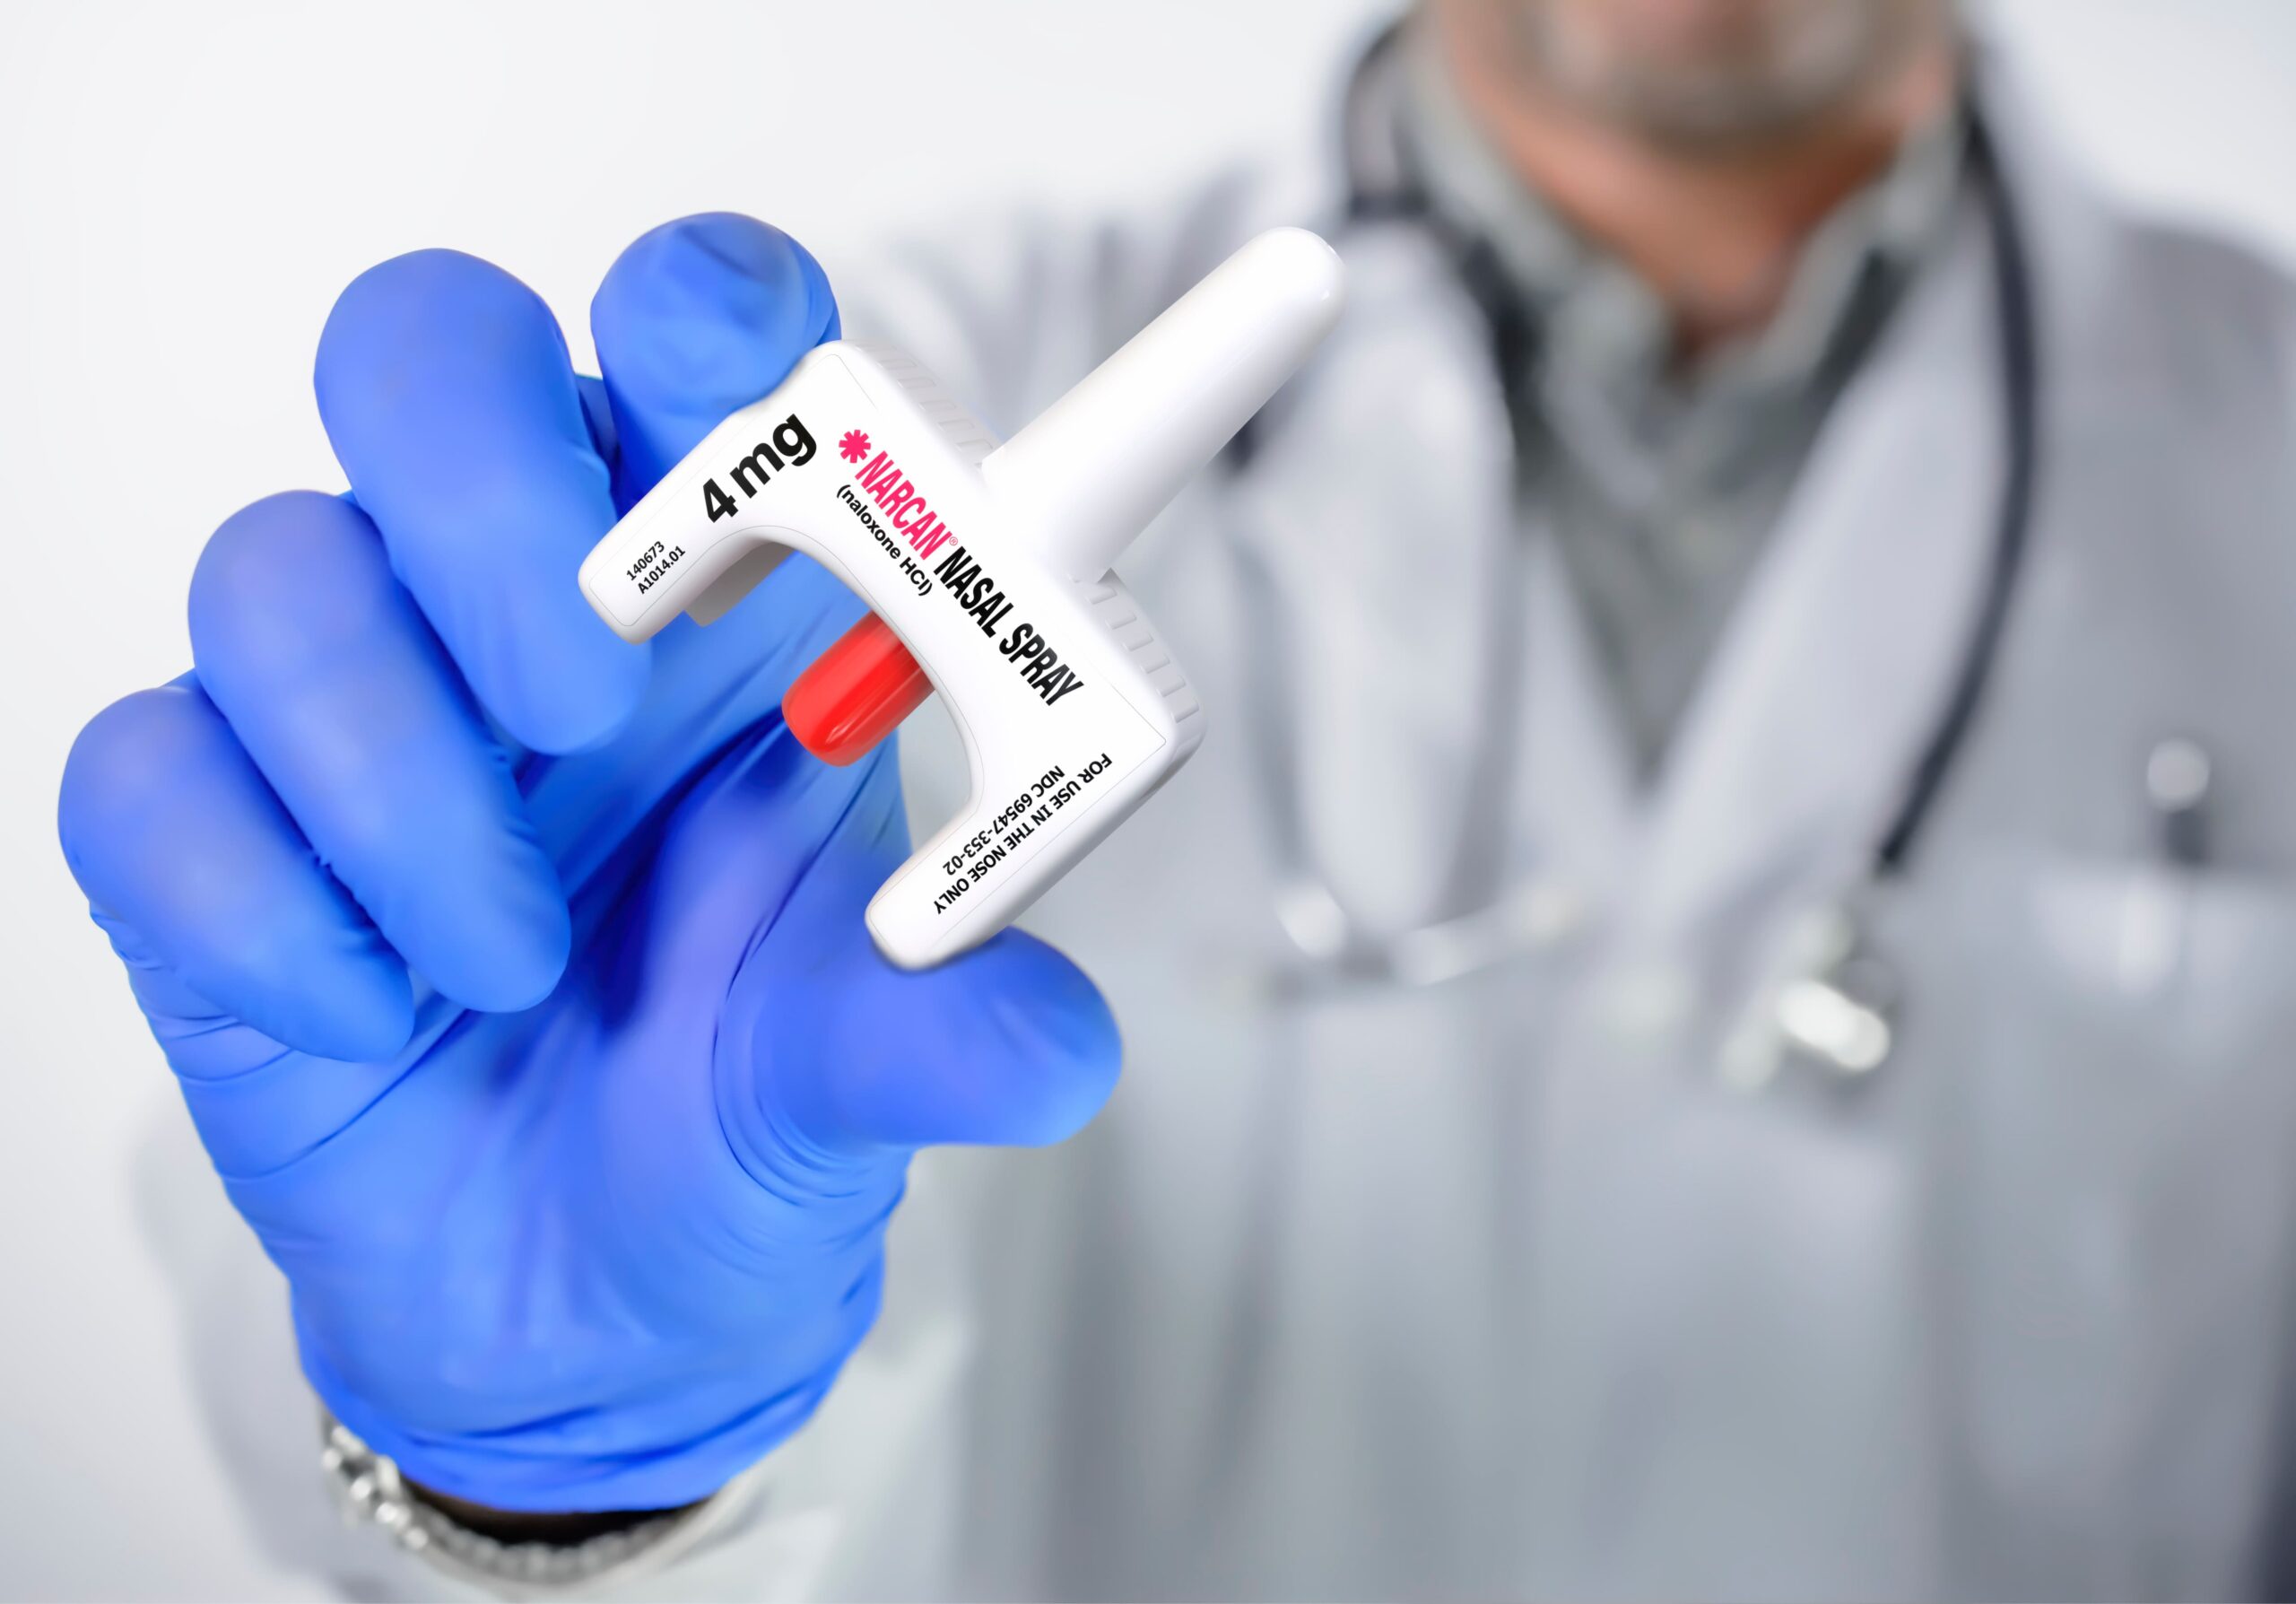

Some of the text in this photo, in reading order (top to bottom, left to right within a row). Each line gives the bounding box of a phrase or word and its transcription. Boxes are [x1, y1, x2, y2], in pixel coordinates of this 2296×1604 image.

[702, 413, 817, 523] 4 mg
[836, 484, 901, 560] (naloxone
[626, 541, 665, 581] 140673
[638, 545, 686, 595] A1014.01
[933, 545, 1014, 639] NASAL
[998, 623, 1084, 706] SPRAY
[934, 753, 1113, 915] FOR USE IN THE NOSE ONLY
[942, 765, 1065, 876] NDC 69547-353-02
